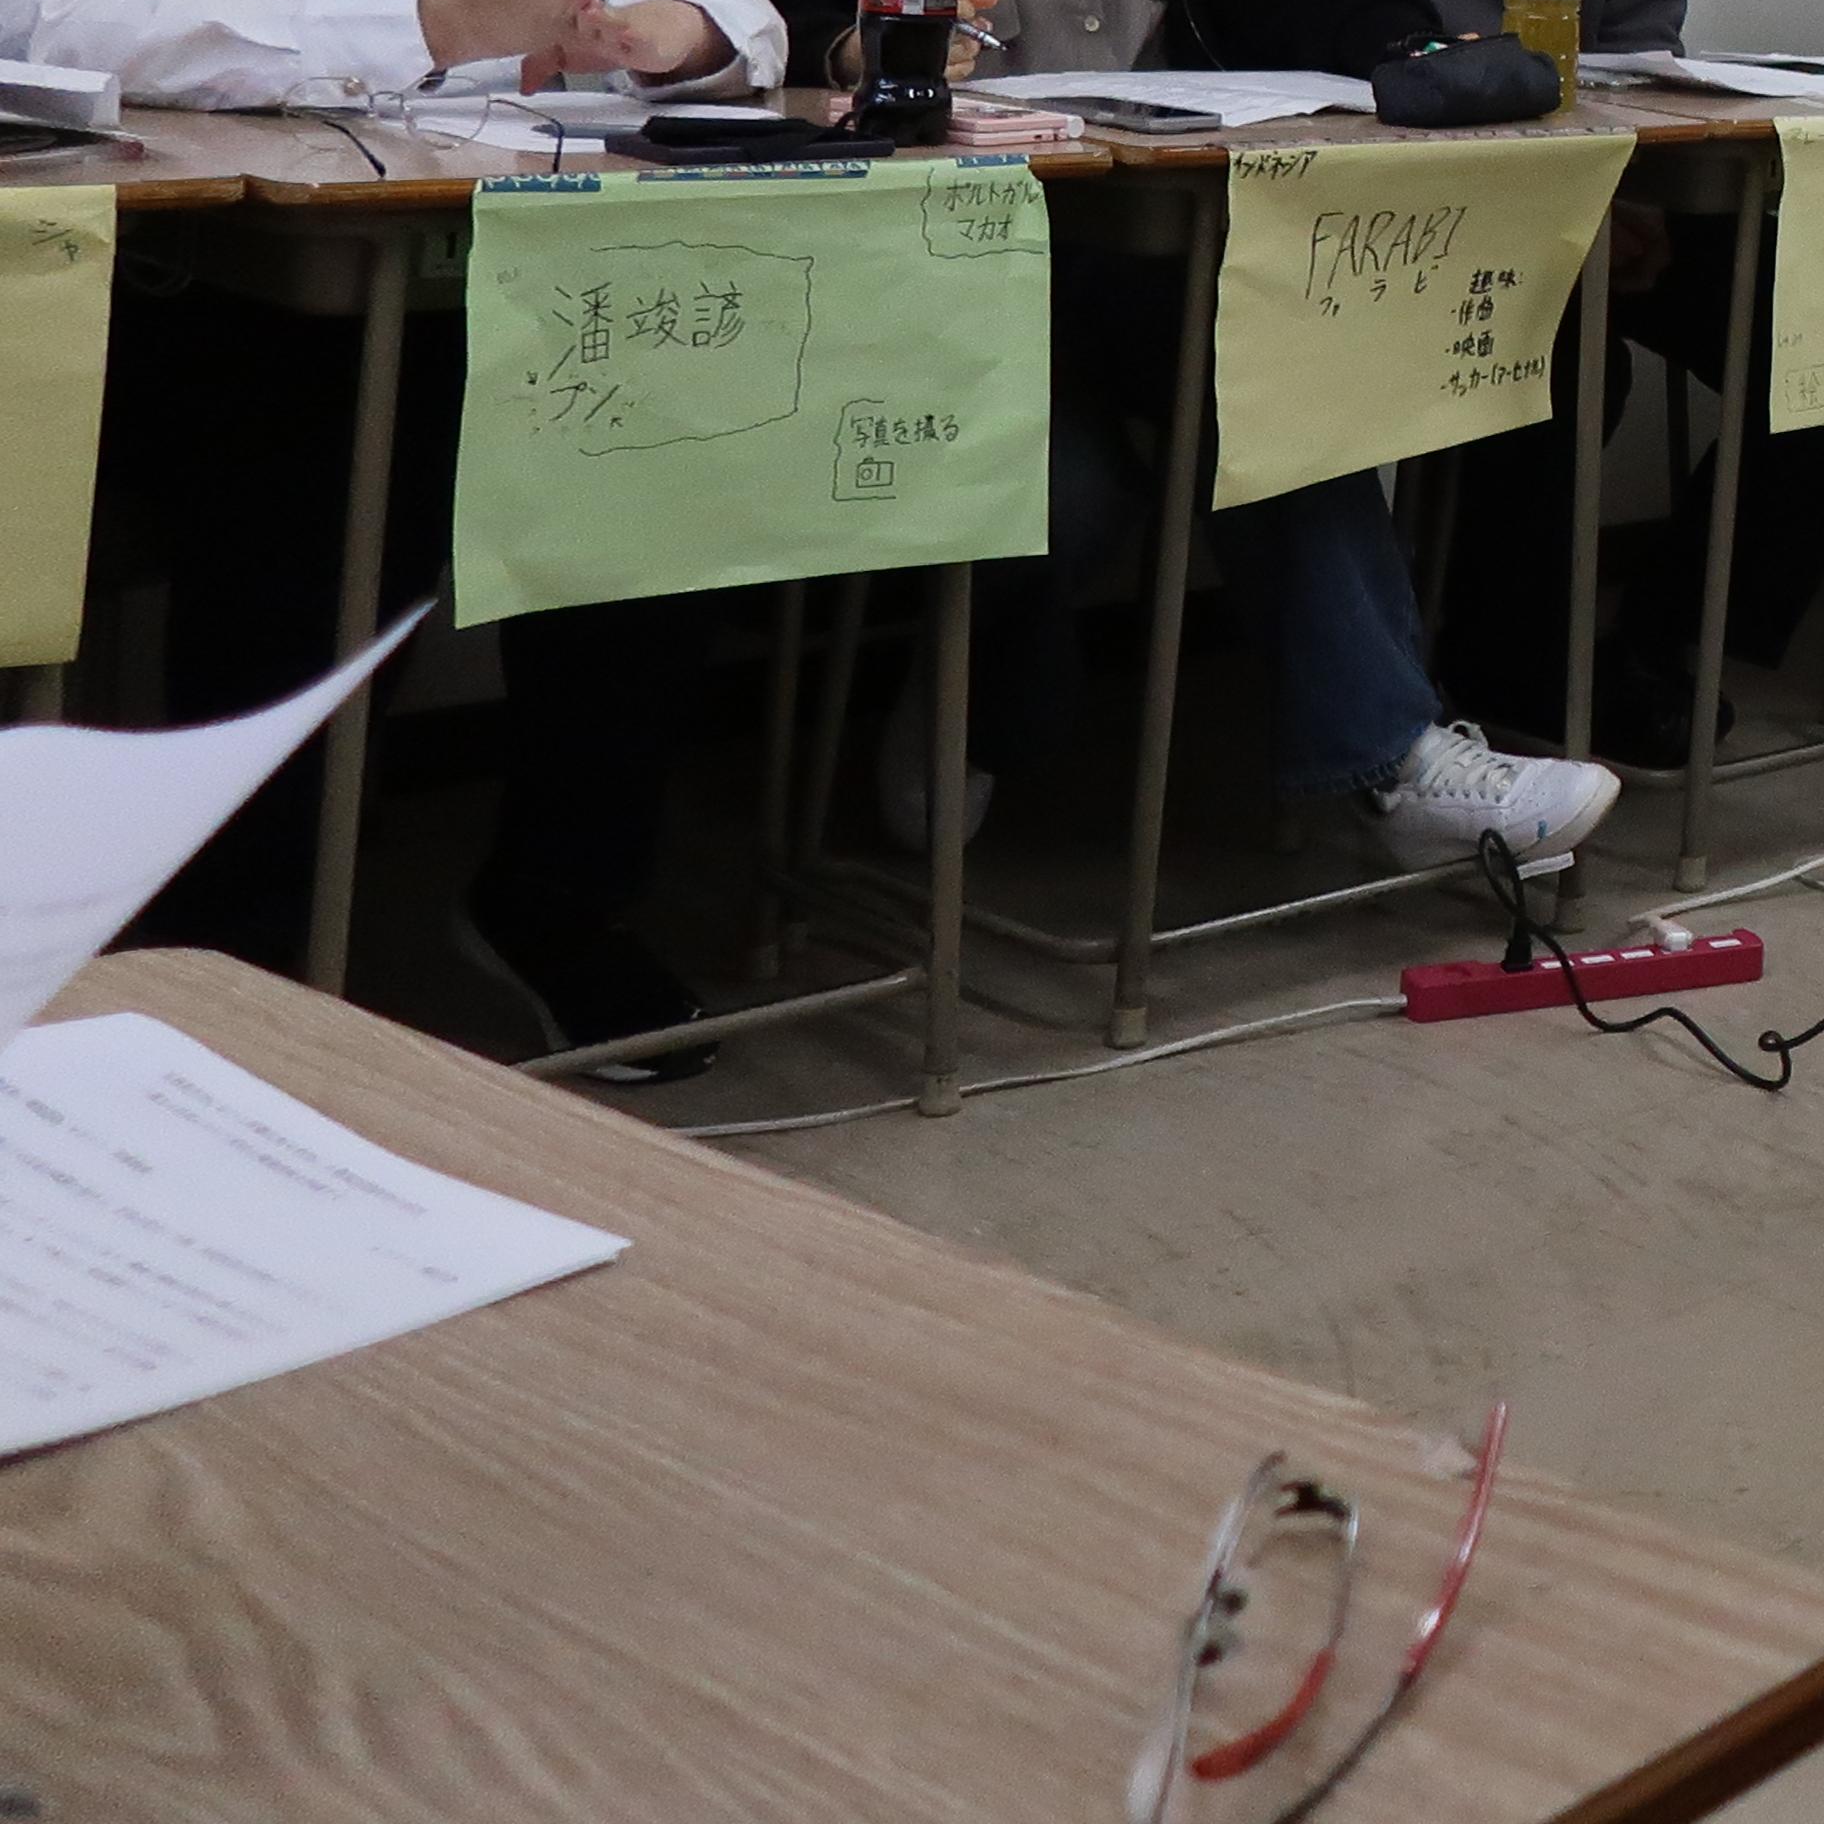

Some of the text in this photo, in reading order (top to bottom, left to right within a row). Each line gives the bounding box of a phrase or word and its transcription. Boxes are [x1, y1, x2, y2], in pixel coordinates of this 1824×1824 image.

[1232, 149, 1318, 181] インドネシア
[941, 181, 1045, 214] ポルトガル
[956, 216, 1014, 243] マカオ
[1305, 206, 1468, 300] FARABI
[547, 280, 746, 382] 潘竣諺
